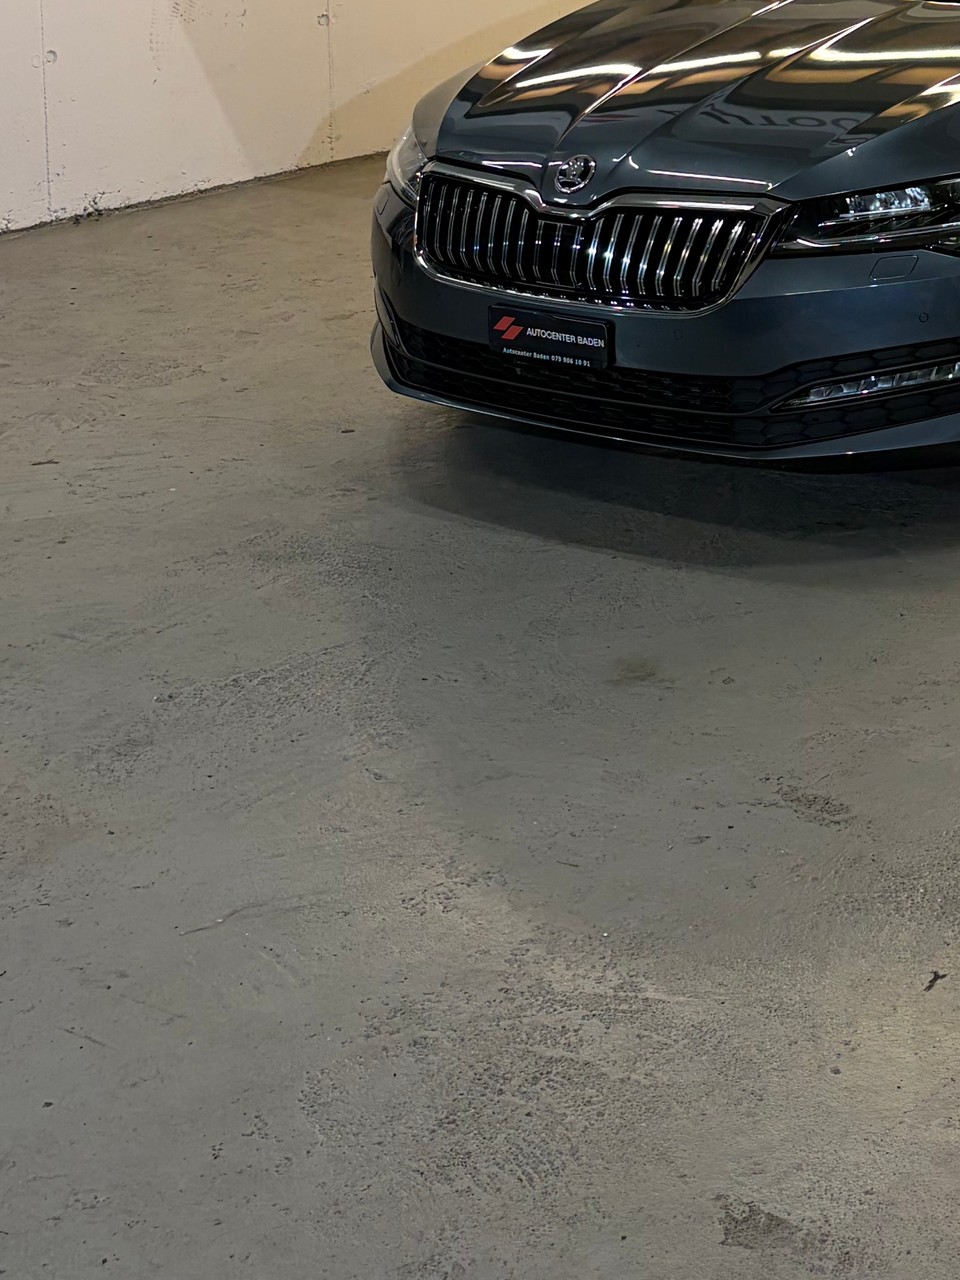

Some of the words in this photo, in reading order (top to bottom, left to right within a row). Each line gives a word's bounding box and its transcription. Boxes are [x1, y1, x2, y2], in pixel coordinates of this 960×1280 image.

[526, 327, 576, 343] AUTOCENTER
[577, 336, 605, 348] BADEN
[502, 347, 532, 357] Autocenter
